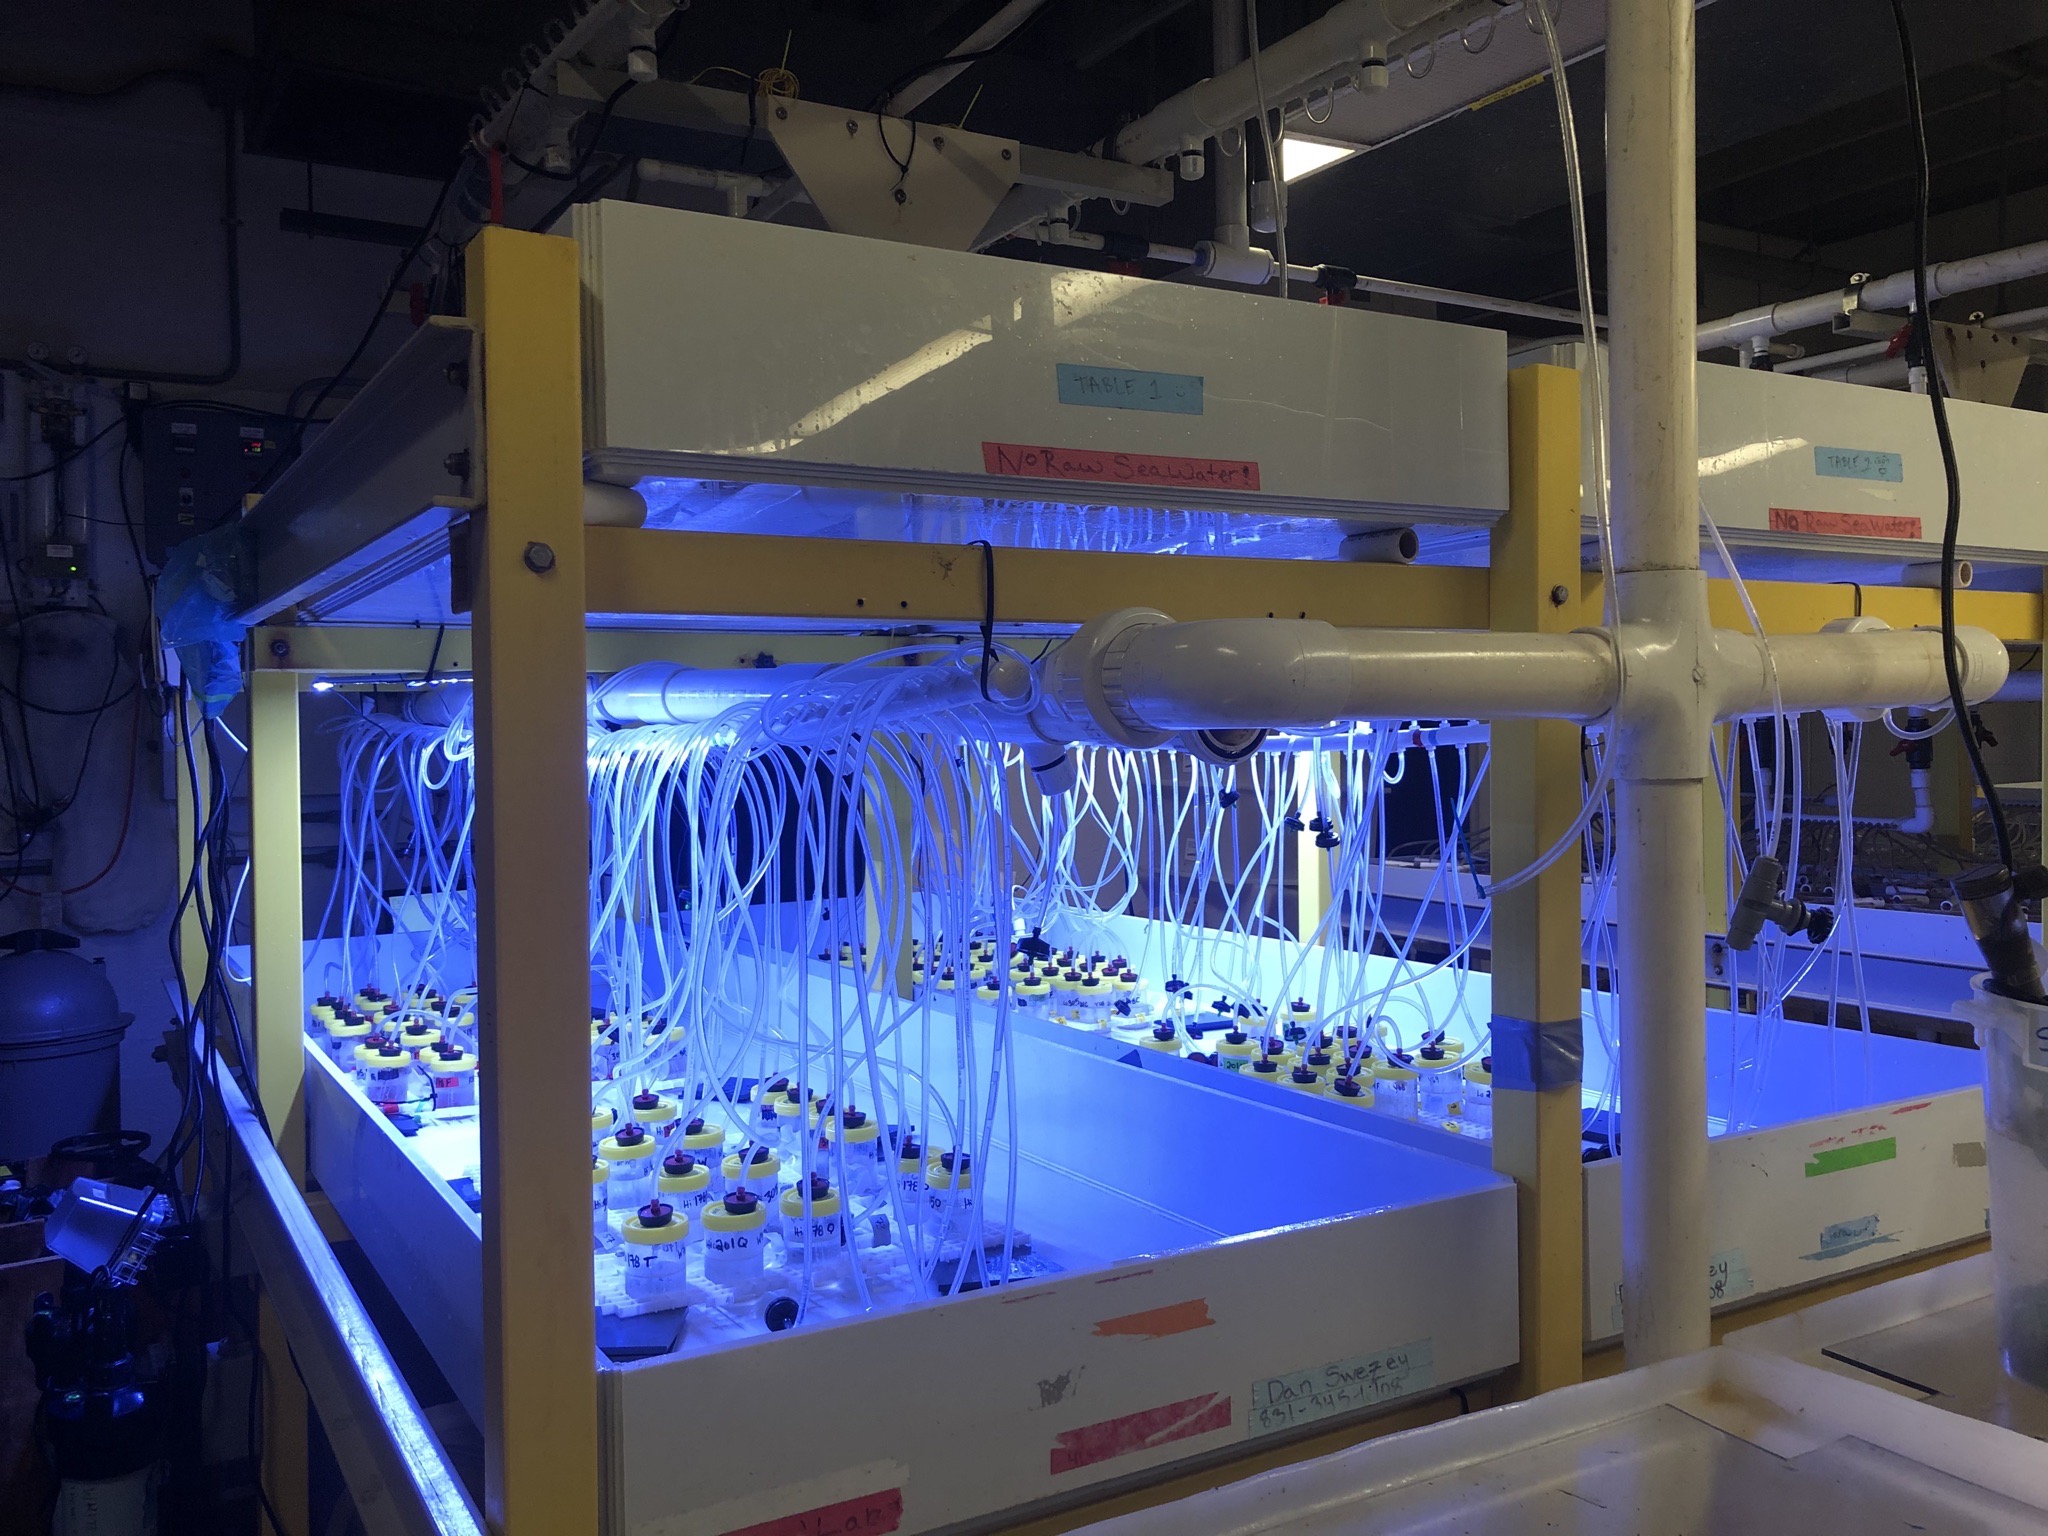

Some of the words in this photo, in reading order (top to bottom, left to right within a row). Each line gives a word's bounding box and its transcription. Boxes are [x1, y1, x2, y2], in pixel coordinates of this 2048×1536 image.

[1074, 376, 1136, 396] TABLE
[1150, 379, 1162, 400] 1
[1827, 456, 1860, 470] TABLE
[1775, 511, 1800, 532] No
[643, 1255, 658, 1268] T
[1268, 1379, 1313, 1404] Dan
